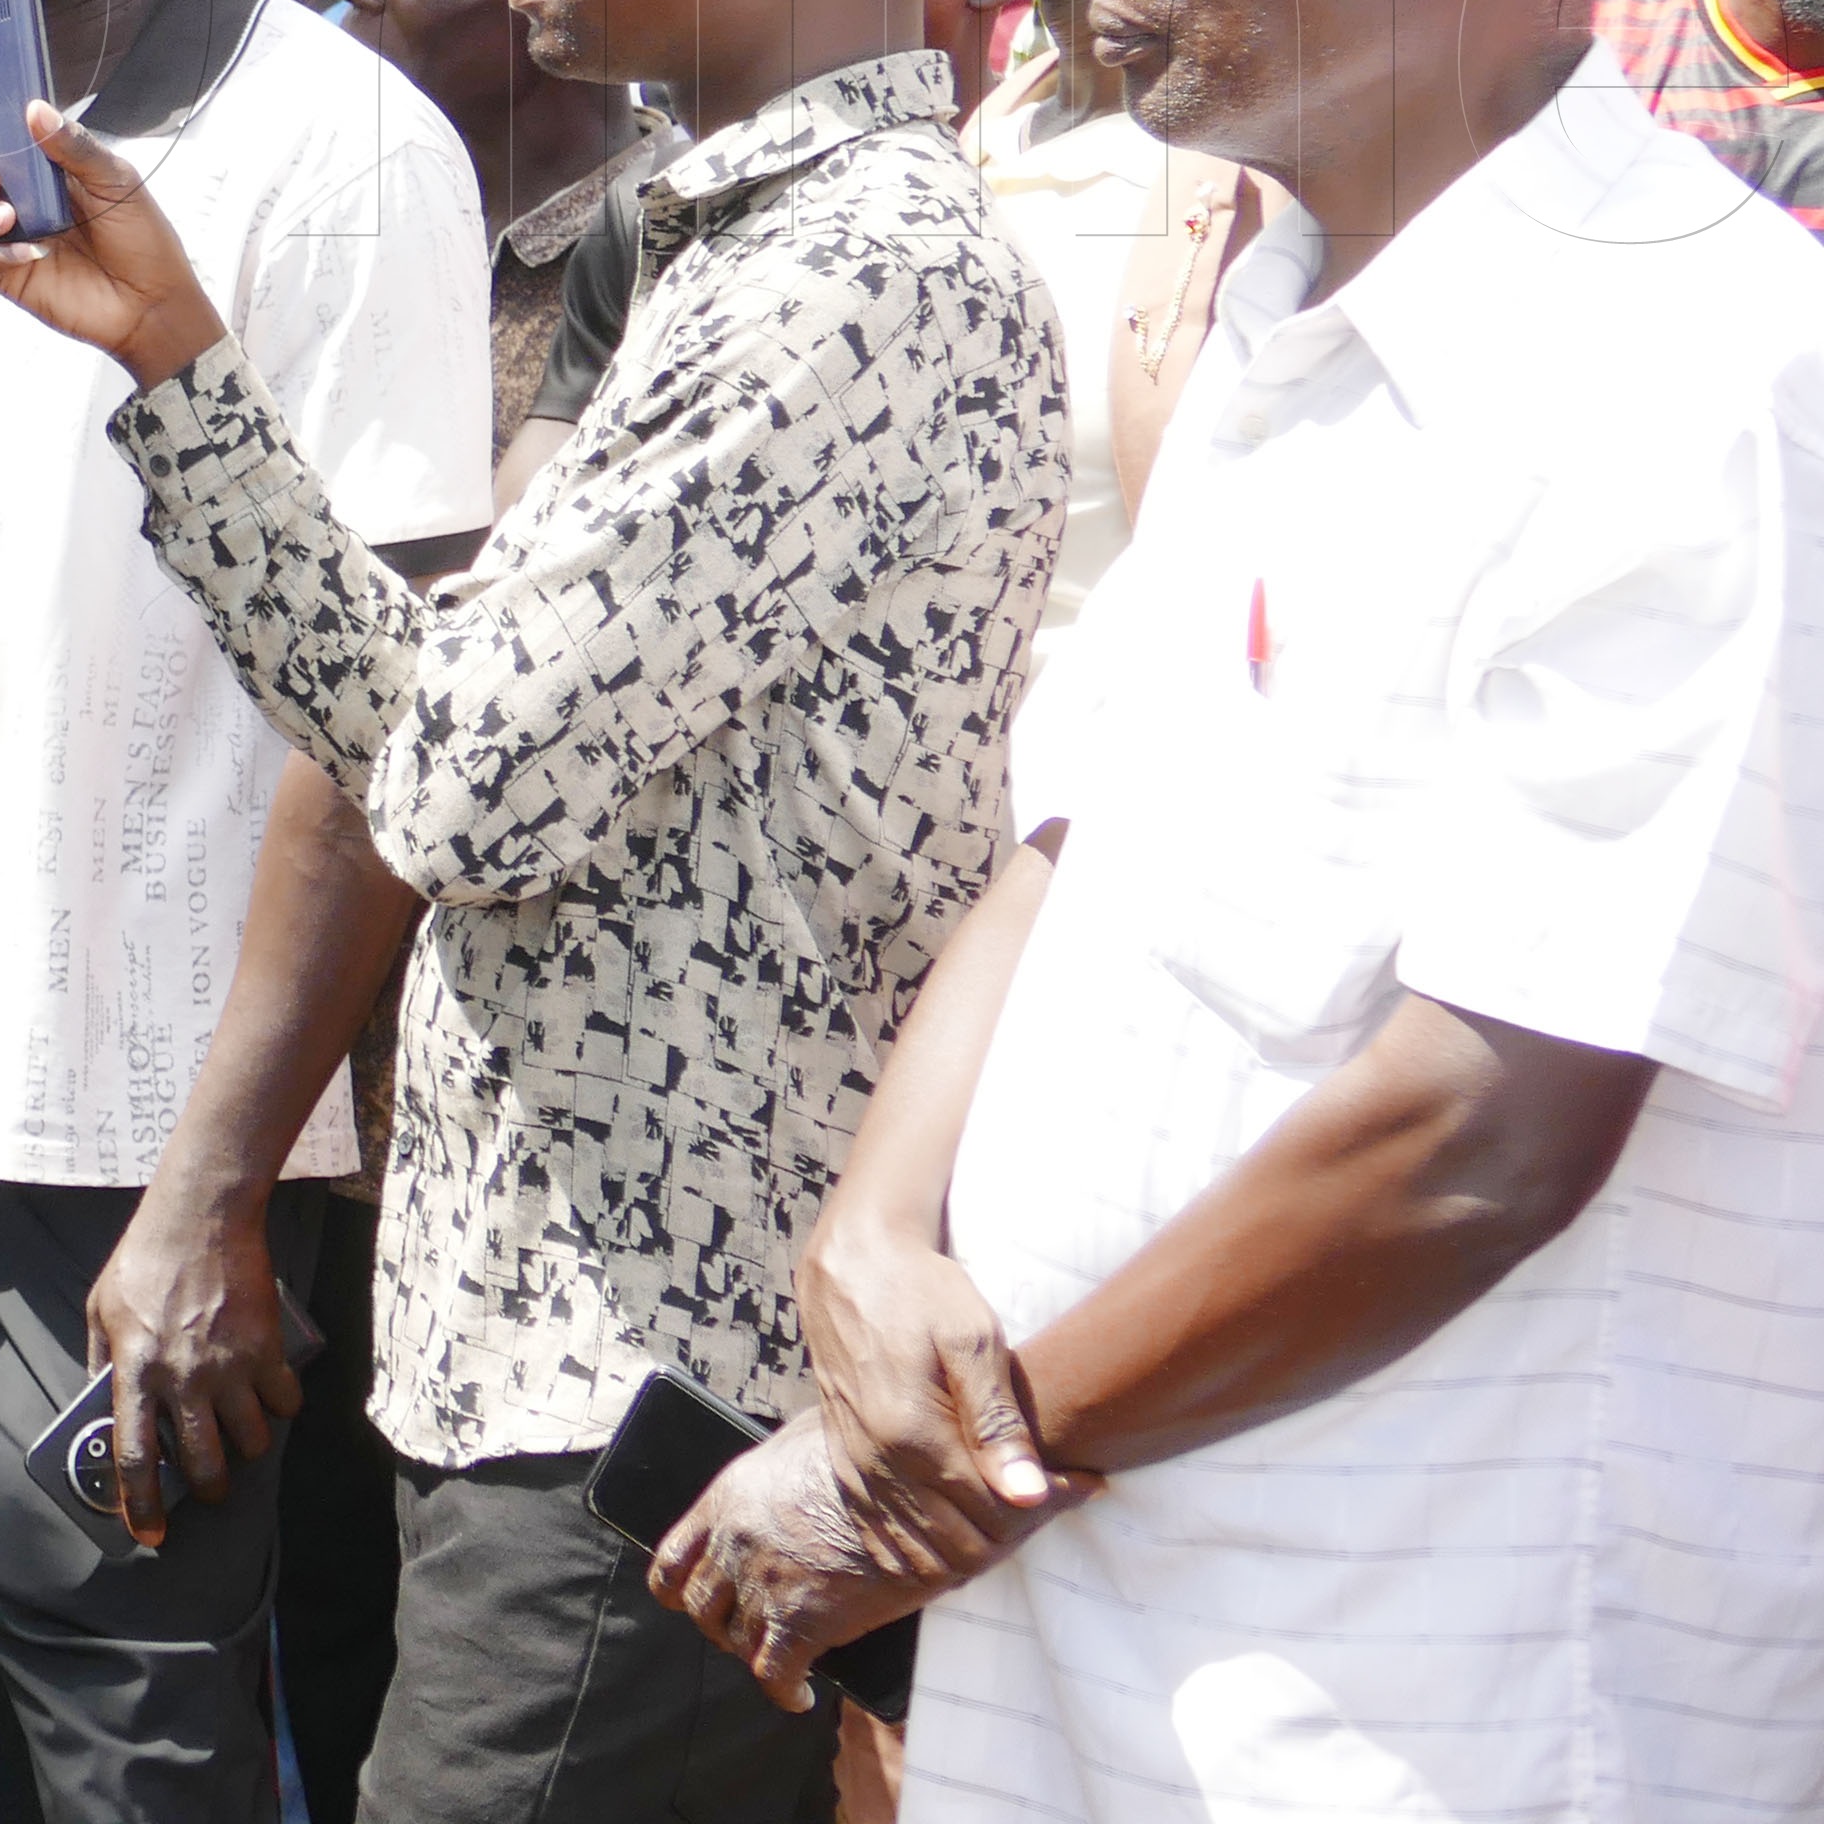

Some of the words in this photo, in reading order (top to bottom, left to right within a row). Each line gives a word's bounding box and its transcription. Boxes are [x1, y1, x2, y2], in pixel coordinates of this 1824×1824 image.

[90, 795, 107, 883] MEN
[145, 711, 180, 903] BUSINESS
[185, 817, 210, 935] VOGUE
[47, 907, 72, 994] MEN
